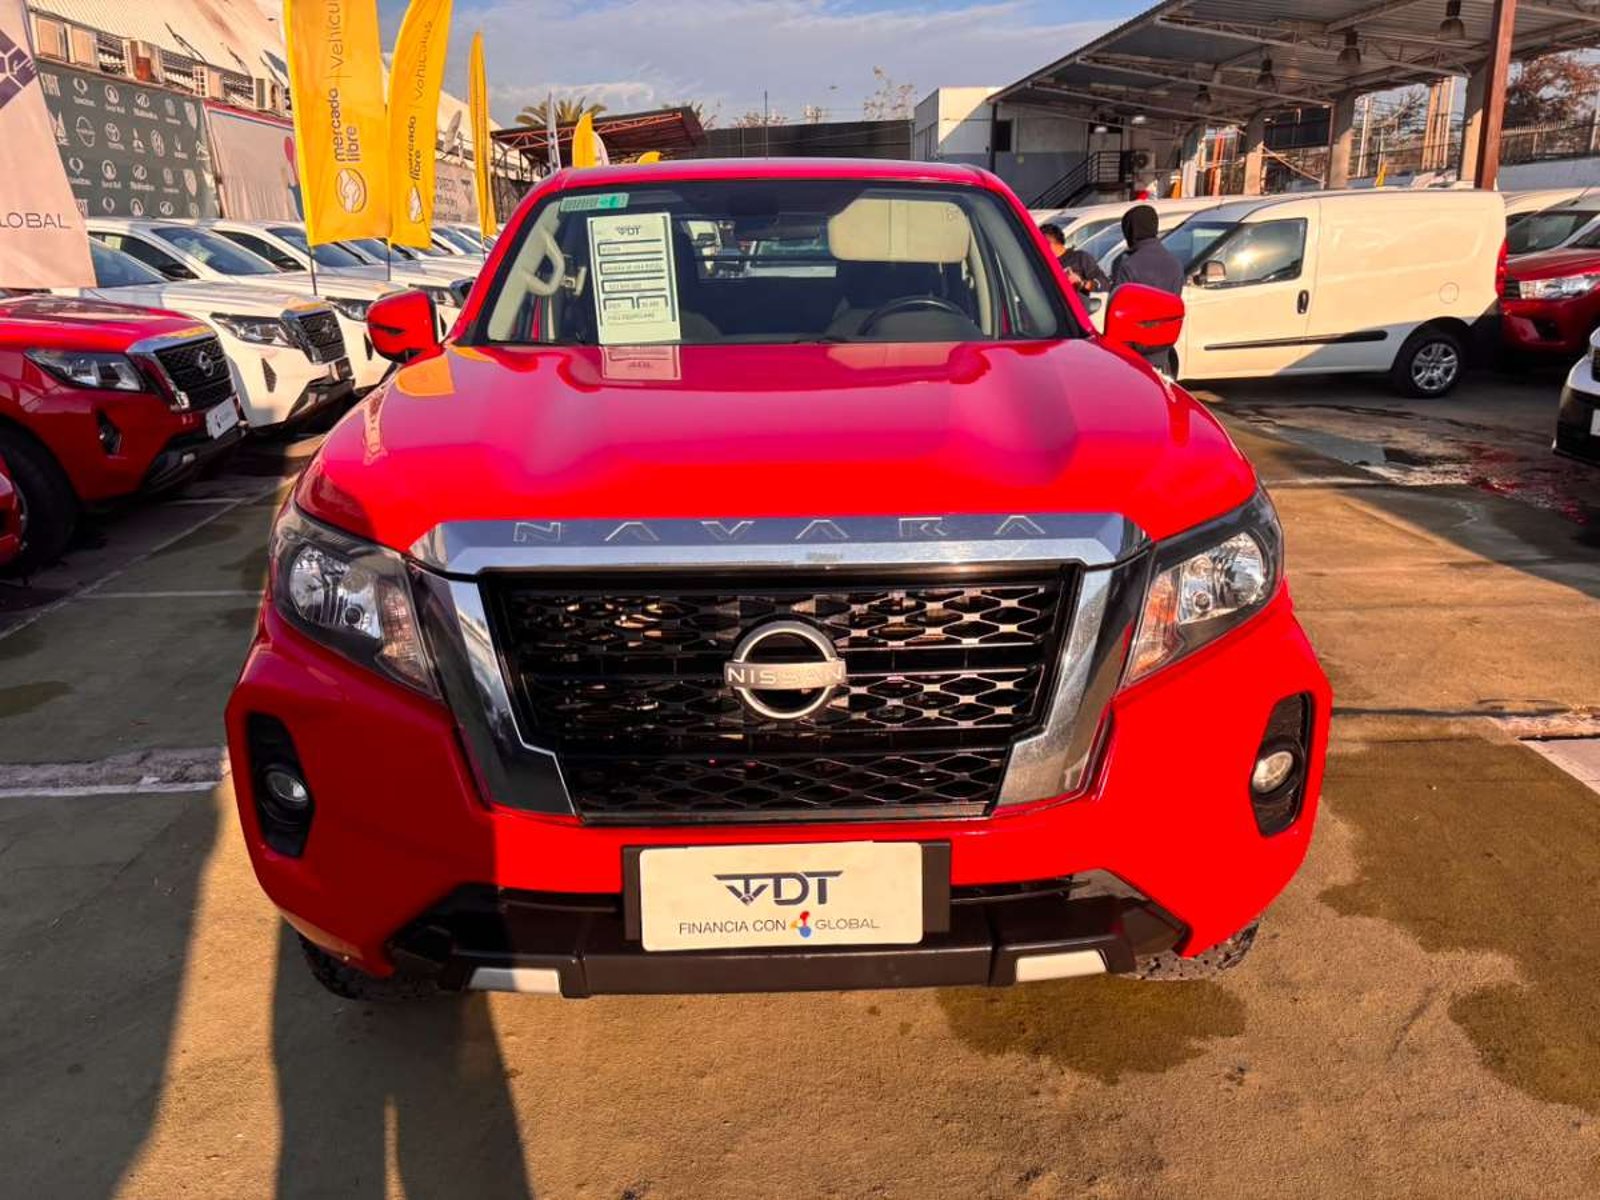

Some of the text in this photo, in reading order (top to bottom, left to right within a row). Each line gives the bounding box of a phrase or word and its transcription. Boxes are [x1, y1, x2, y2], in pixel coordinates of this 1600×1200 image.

[326, 88, 345, 161] mercado
[345, 126, 361, 162] libre
[512, 515, 1046, 542] NAVARA
[727, 666, 843, 684] NISSAN
[679, 918, 880, 935] FINANCIA CON GLOBAL
